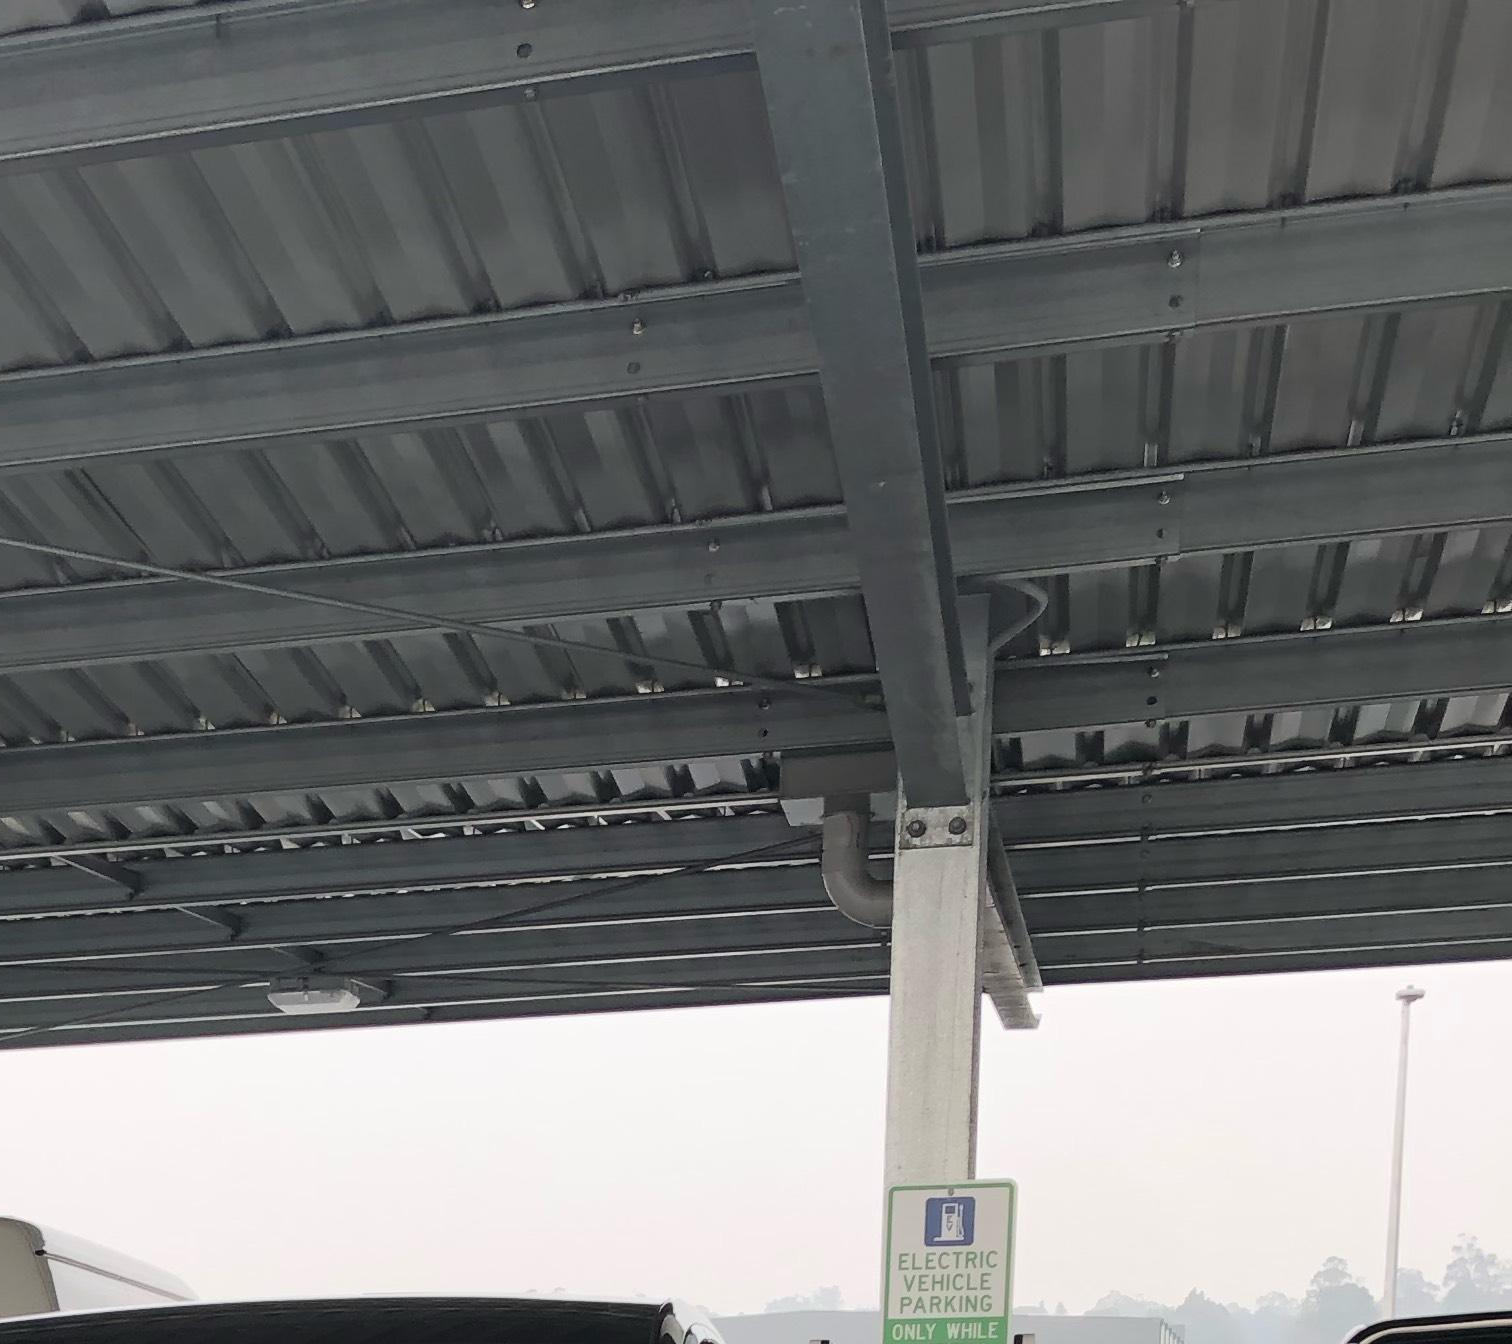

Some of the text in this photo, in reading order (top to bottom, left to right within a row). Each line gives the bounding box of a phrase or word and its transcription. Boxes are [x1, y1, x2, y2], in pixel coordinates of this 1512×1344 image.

[898, 1250, 998, 1271] ELECTRIC
[903, 1273, 992, 1292] VEHICLE
[899, 1295, 993, 1314] PARKING
[892, 1321, 999, 1341] ONLY WHILE
